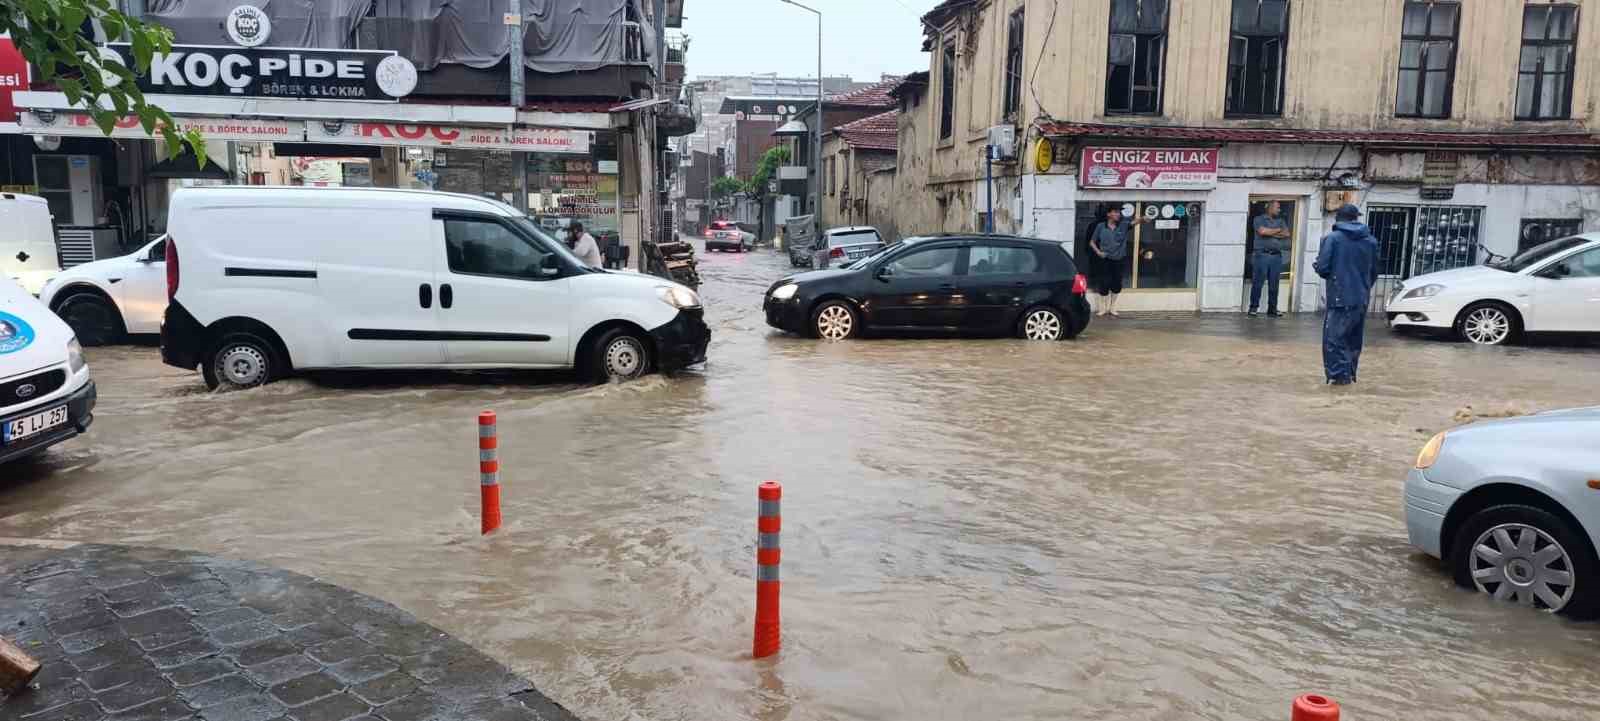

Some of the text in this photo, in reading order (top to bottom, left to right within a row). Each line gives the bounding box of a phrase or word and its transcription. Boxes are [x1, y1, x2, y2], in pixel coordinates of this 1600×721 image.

[151, 52, 253, 93] KOÇ
[259, 54, 366, 79] PİDE
[262, 82, 366, 97] BÖREK & LOKMA
[252, 126, 288, 135] SALONU
[1155, 151, 1210, 164] EMLAK
[10, 406, 66, 437] 45 LJ 257
